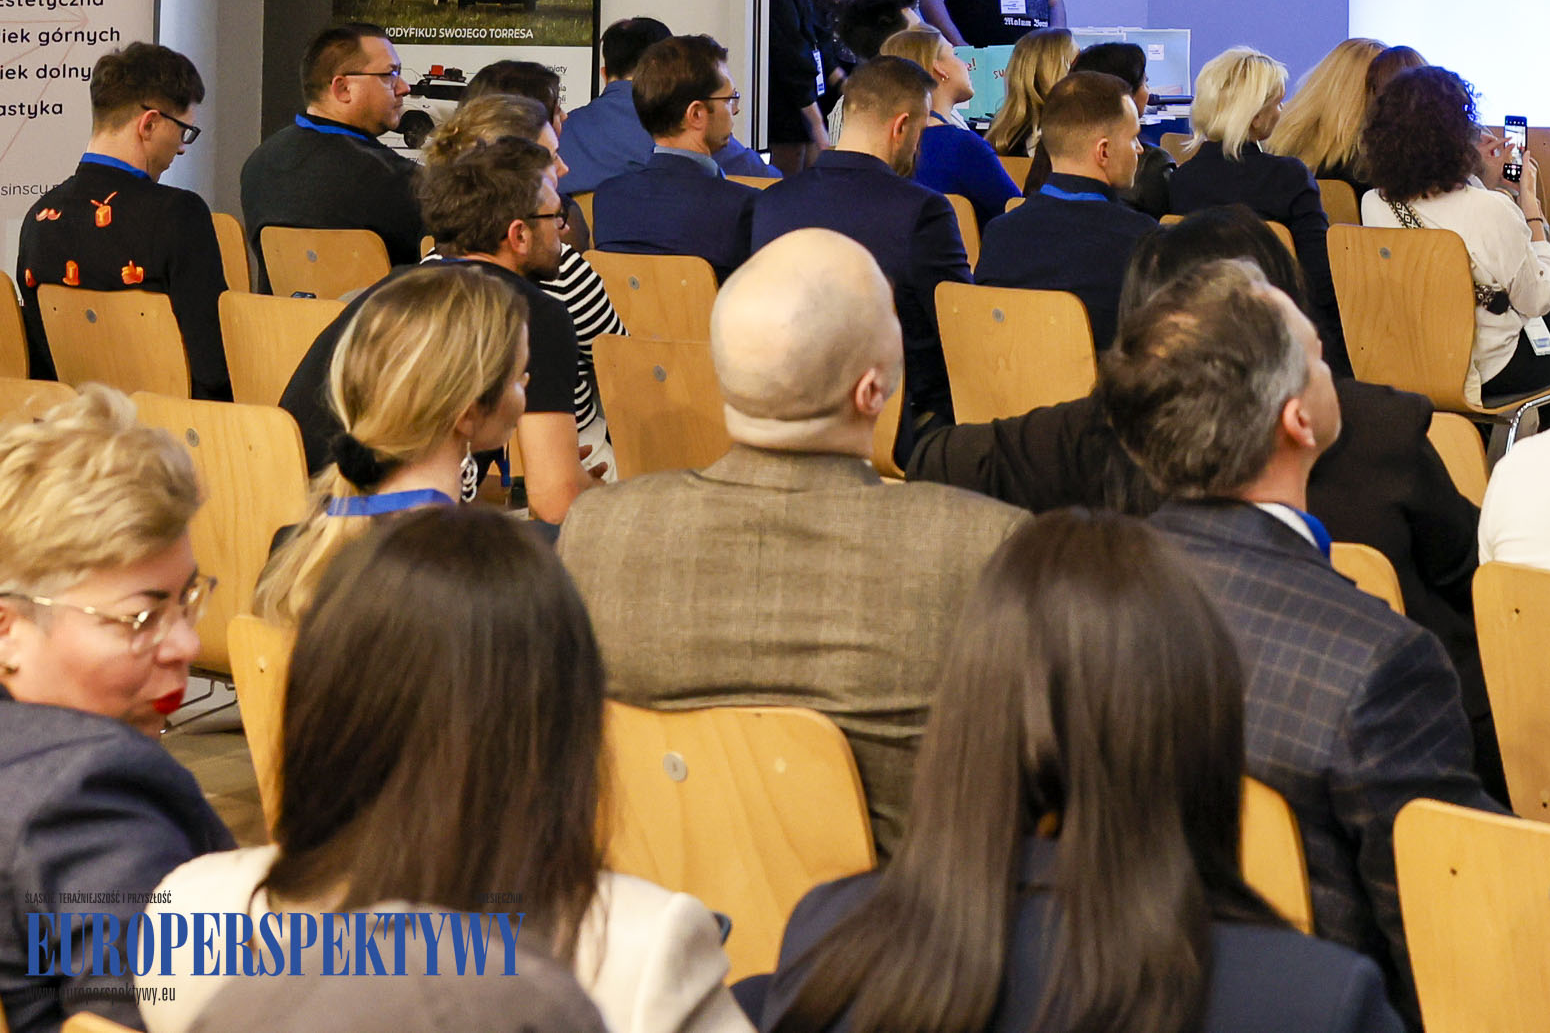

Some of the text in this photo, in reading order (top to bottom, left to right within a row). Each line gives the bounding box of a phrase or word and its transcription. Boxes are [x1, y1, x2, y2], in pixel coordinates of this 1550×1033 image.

[38, 27, 120, 46] górnych
[438, 28, 487, 39] SWOJEGO
[489, 28, 534, 39] TORRESA
[36, 63, 92, 81] dolny
